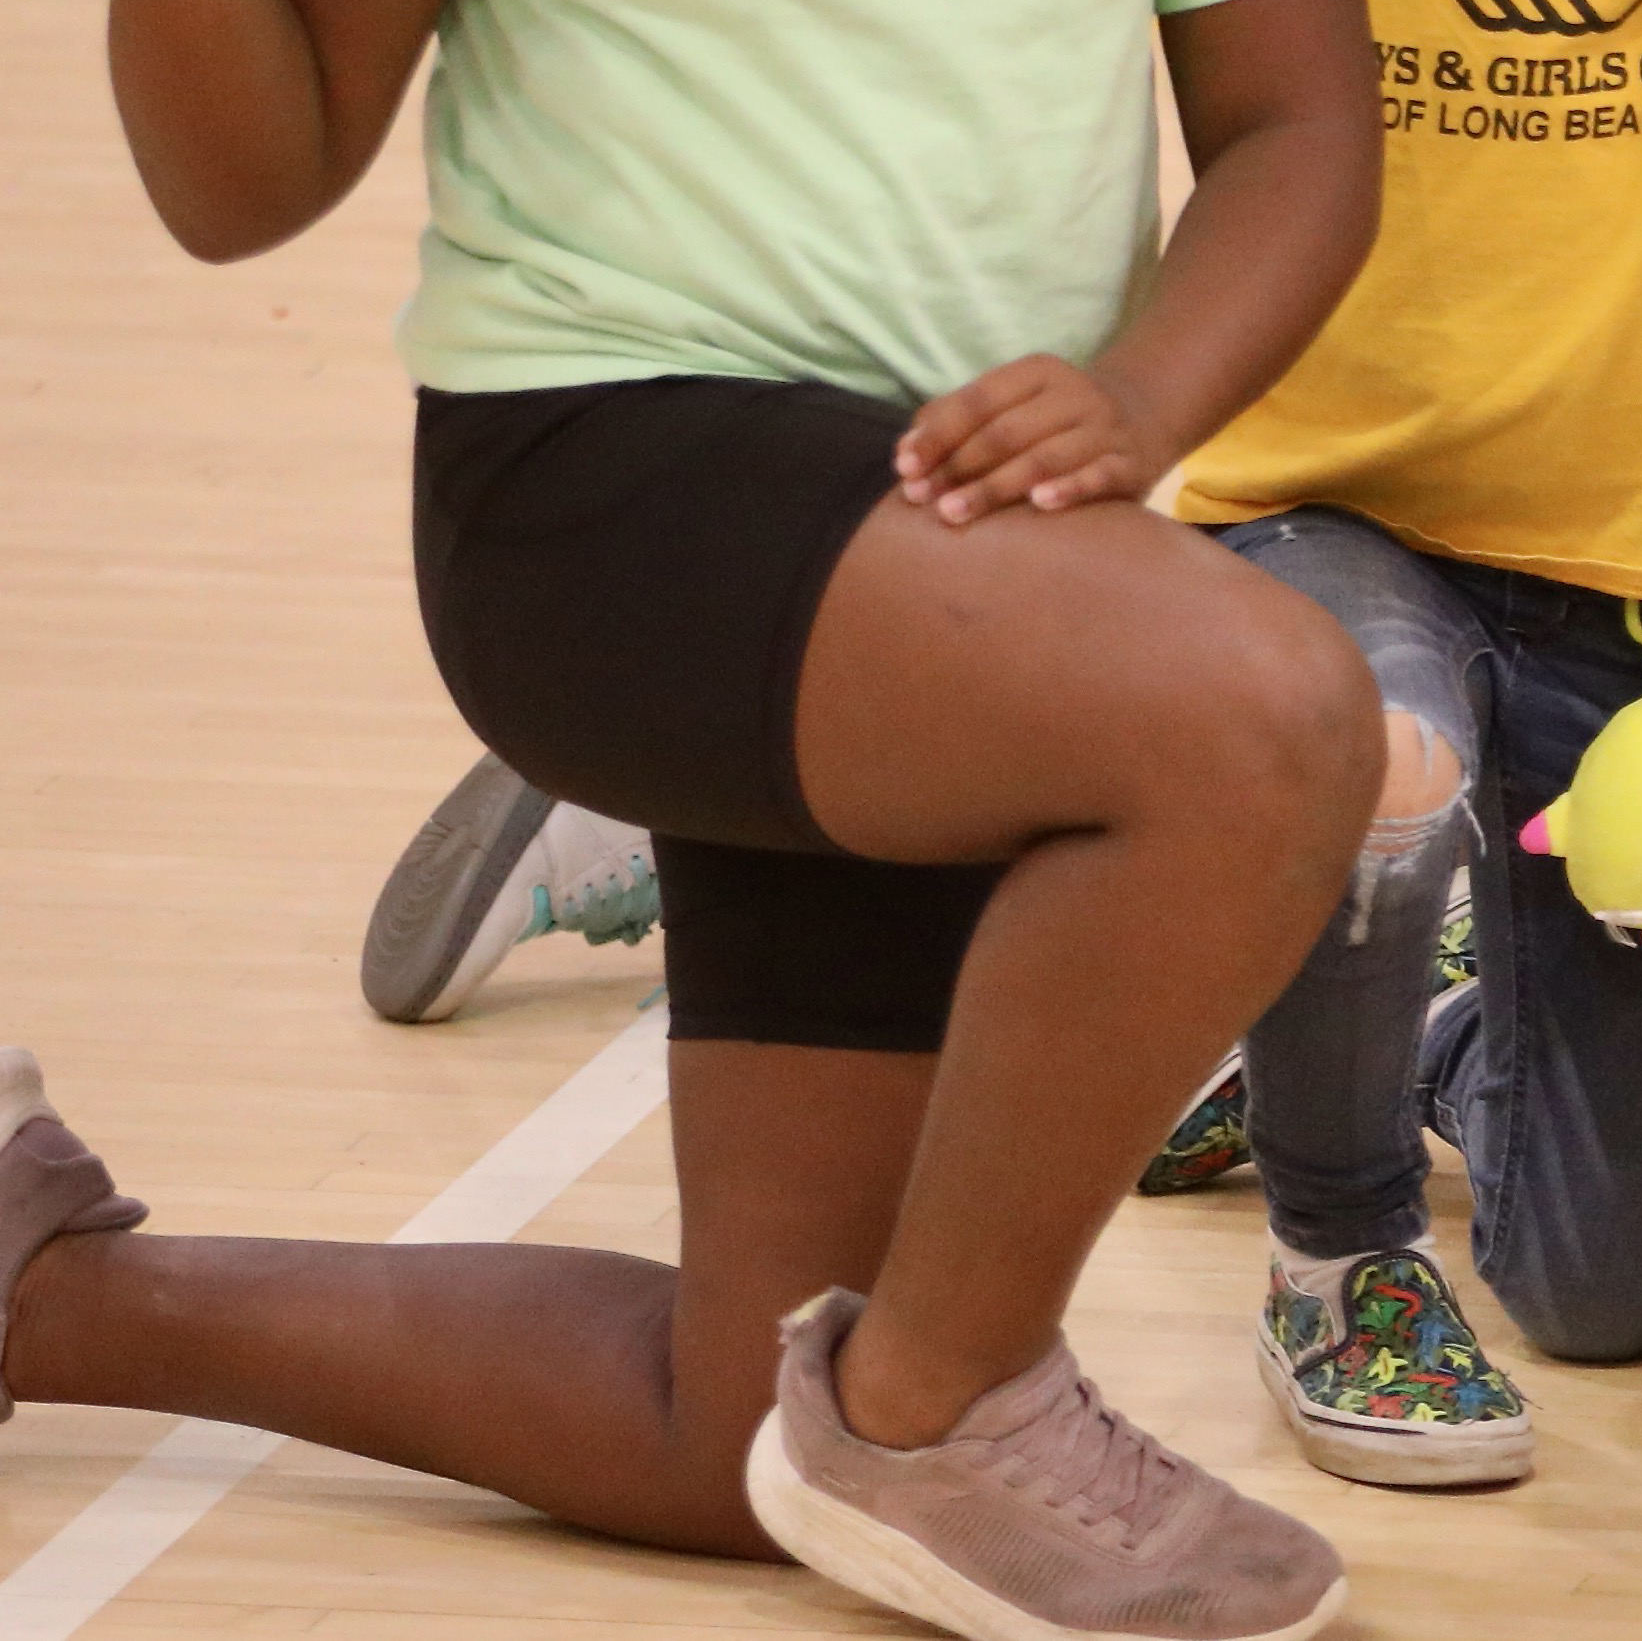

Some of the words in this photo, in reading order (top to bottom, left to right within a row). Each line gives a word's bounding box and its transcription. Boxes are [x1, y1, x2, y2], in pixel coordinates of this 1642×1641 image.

[1433, 50, 1475, 91] &
[1486, 51, 1629, 98] GIRLS
[1382, 97, 1426, 133] OF
[1438, 102, 1549, 142] LONG
